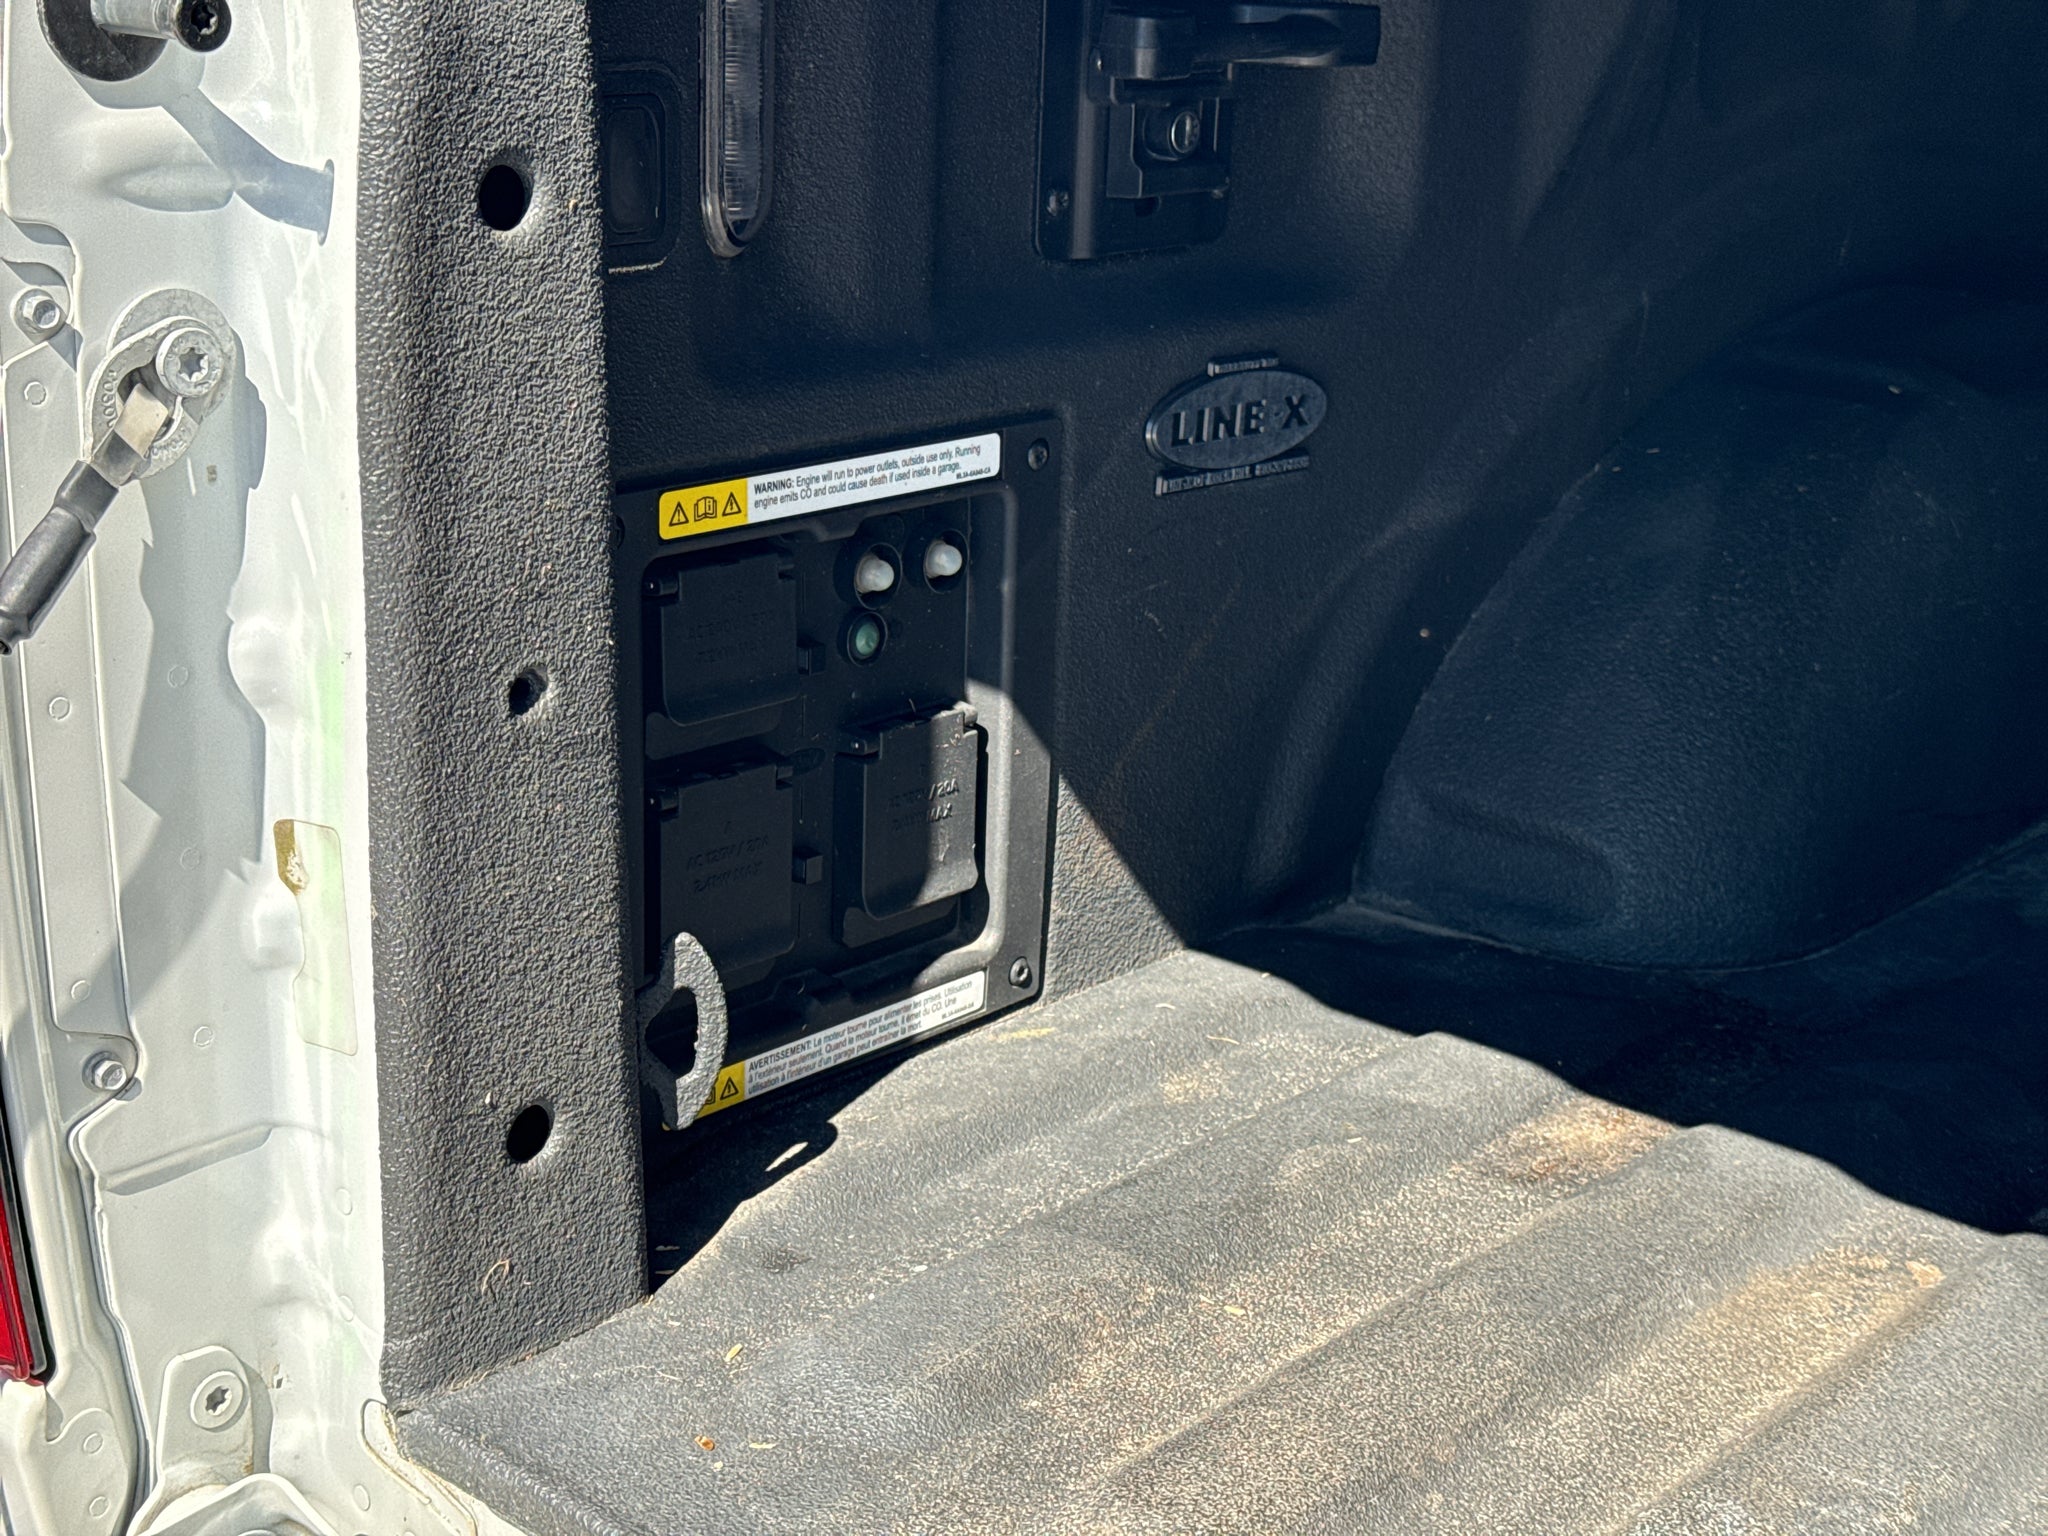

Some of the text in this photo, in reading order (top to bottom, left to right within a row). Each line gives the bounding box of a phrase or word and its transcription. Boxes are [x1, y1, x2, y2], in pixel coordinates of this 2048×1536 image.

[754, 444, 981, 494] WARNING: Engine will run to power outlets, outside use only. Running
[754, 496, 778, 510] engine
[780, 491, 798, 504] emits
[800, 488, 812, 500] CO
[814, 485, 826, 496] and
[828, 480, 846, 494] could
[848, 479, 868, 491] cause
[869, 474, 888, 487] death
[889, 472, 894, 482] if
[895, 468, 910, 482] used
[912, 466, 930, 478] inside
[938, 462, 962, 476] garage.
[748, 1072, 754, 1084] à
[824, 1038, 847, 1054] Quand
[848, 1036, 854, 1045] le
[856, 1027, 878, 1042] moteur
[906, 1010, 921, 1023] émet
[922, 1006, 930, 1016] du
[931, 1002, 943, 1014] CO.
[944, 997, 957, 1008] Une
[814, 1038, 822, 1047] Le
[823, 1028, 846, 1044] moteur
[847, 1020, 868, 1034] tourne
[868, 1014, 883, 1028] pour
[884, 1003, 912, 1021] alimenter
[913, 1000, 922, 1010] les
[944, 980, 972, 997] Utilisation
[748, 1076, 780, 1094] utilisation
[780, 1072, 786, 1082] à
[818, 1056, 832, 1068] d'un
[832, 1046, 855, 1064] garage
[856, 1040, 870, 1054] peut
[900, 1026, 906, 1035] la
